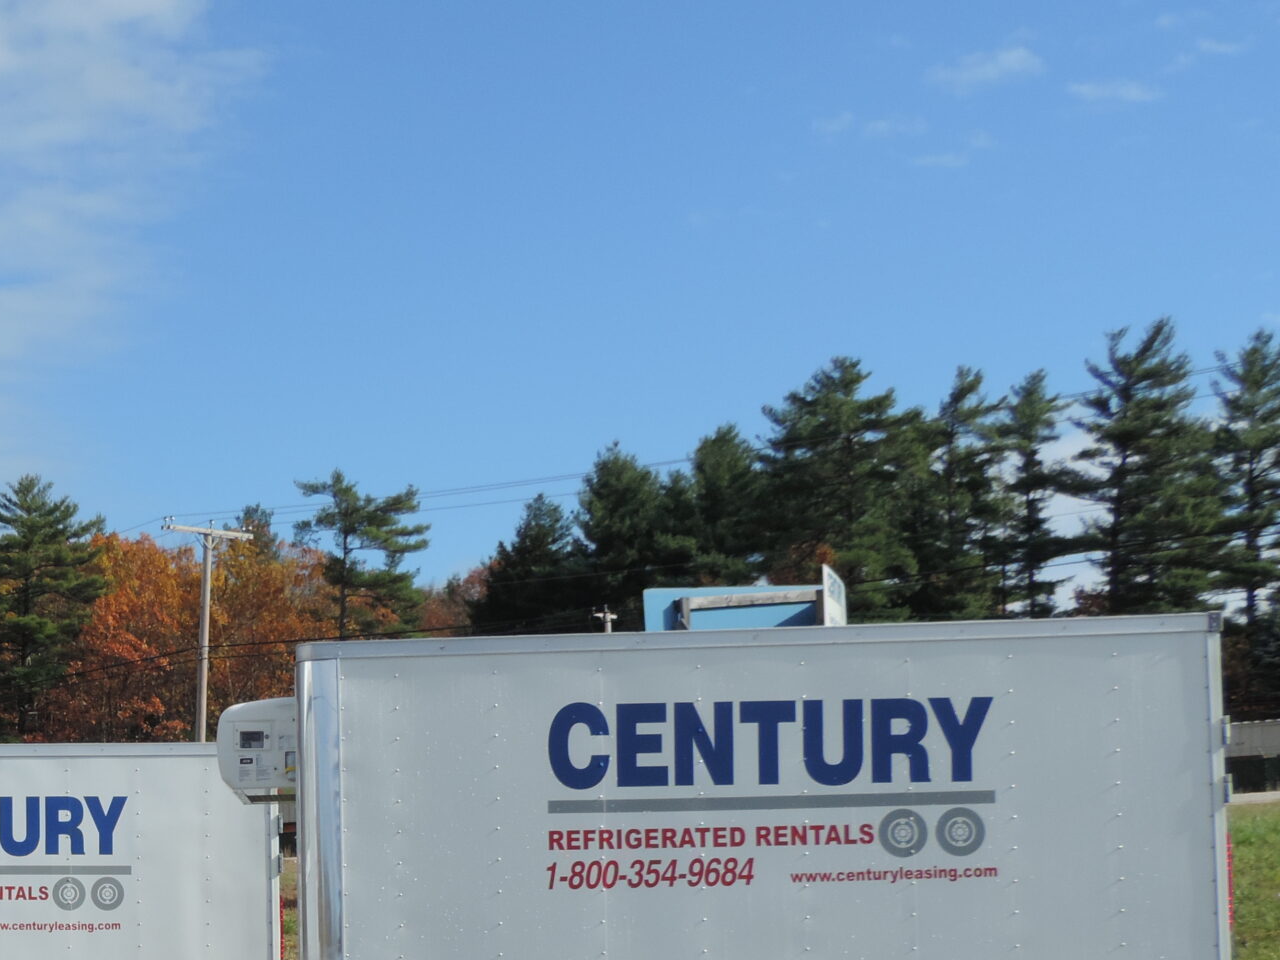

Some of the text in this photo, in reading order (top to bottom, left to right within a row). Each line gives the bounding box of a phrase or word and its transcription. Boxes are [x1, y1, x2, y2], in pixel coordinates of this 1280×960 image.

[548, 697, 994, 790] CENTURY
[548, 824, 875, 851] REFRIGERATED RENTALS
[545, 857, 755, 891] 1-800-354-9684
[790, 865, 999, 883] www.centuryleasing.com
